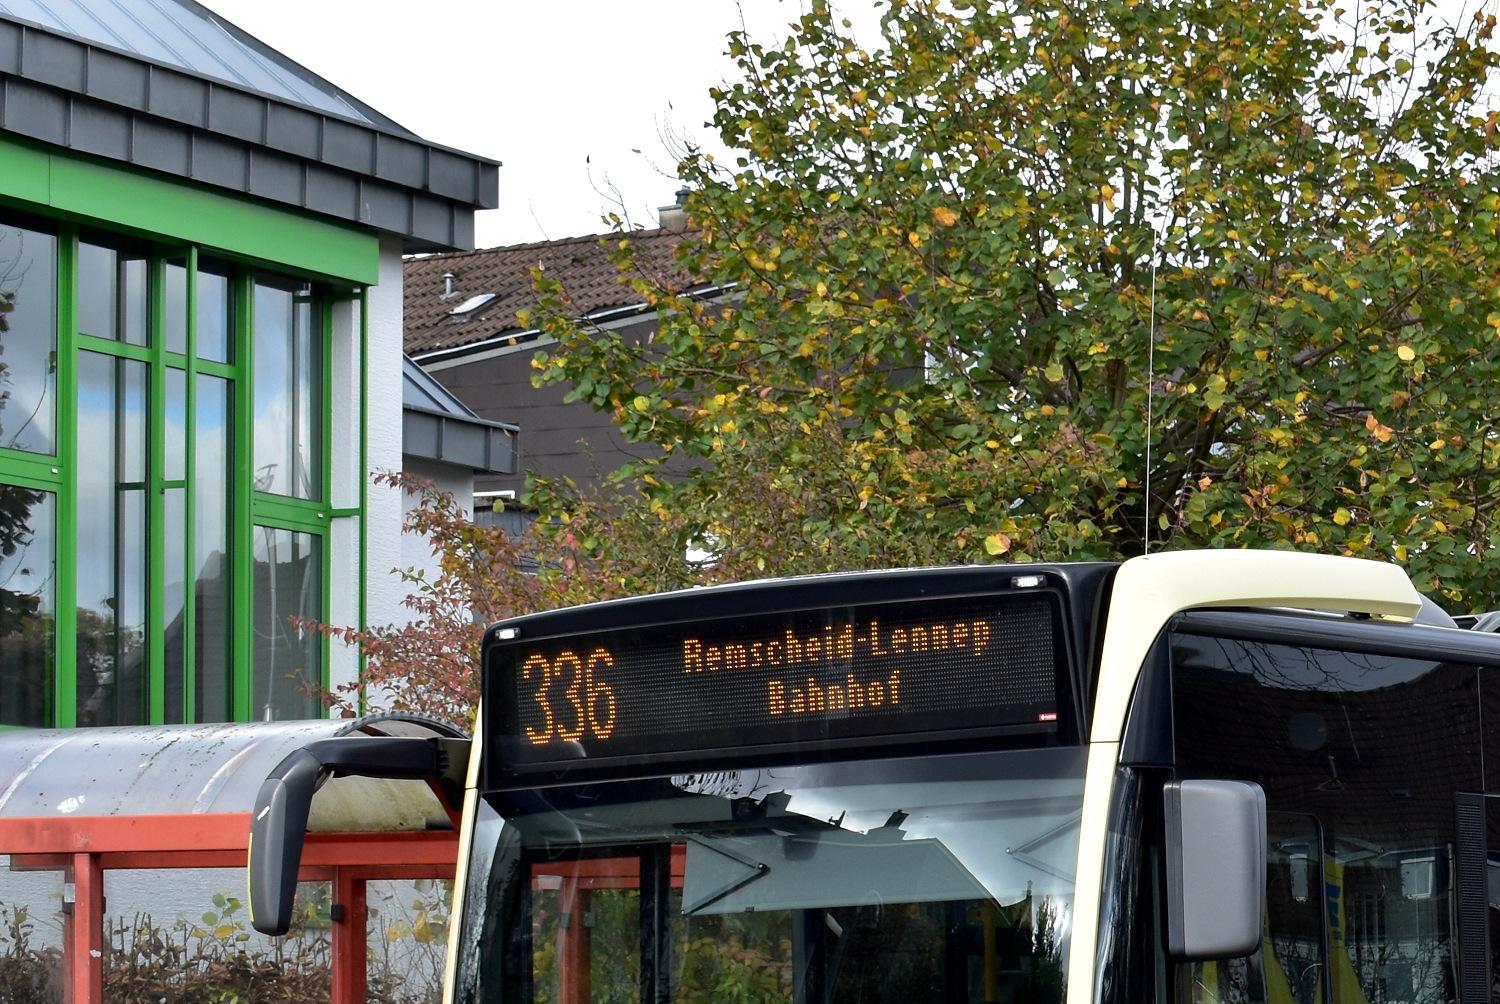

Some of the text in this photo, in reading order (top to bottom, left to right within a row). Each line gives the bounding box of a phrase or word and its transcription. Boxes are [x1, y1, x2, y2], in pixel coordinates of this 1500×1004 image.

[684, 617, 990, 674] Remscheid-Lennep
[522, 648, 618, 745] 336
[769, 669, 901, 716] Bahnhof
